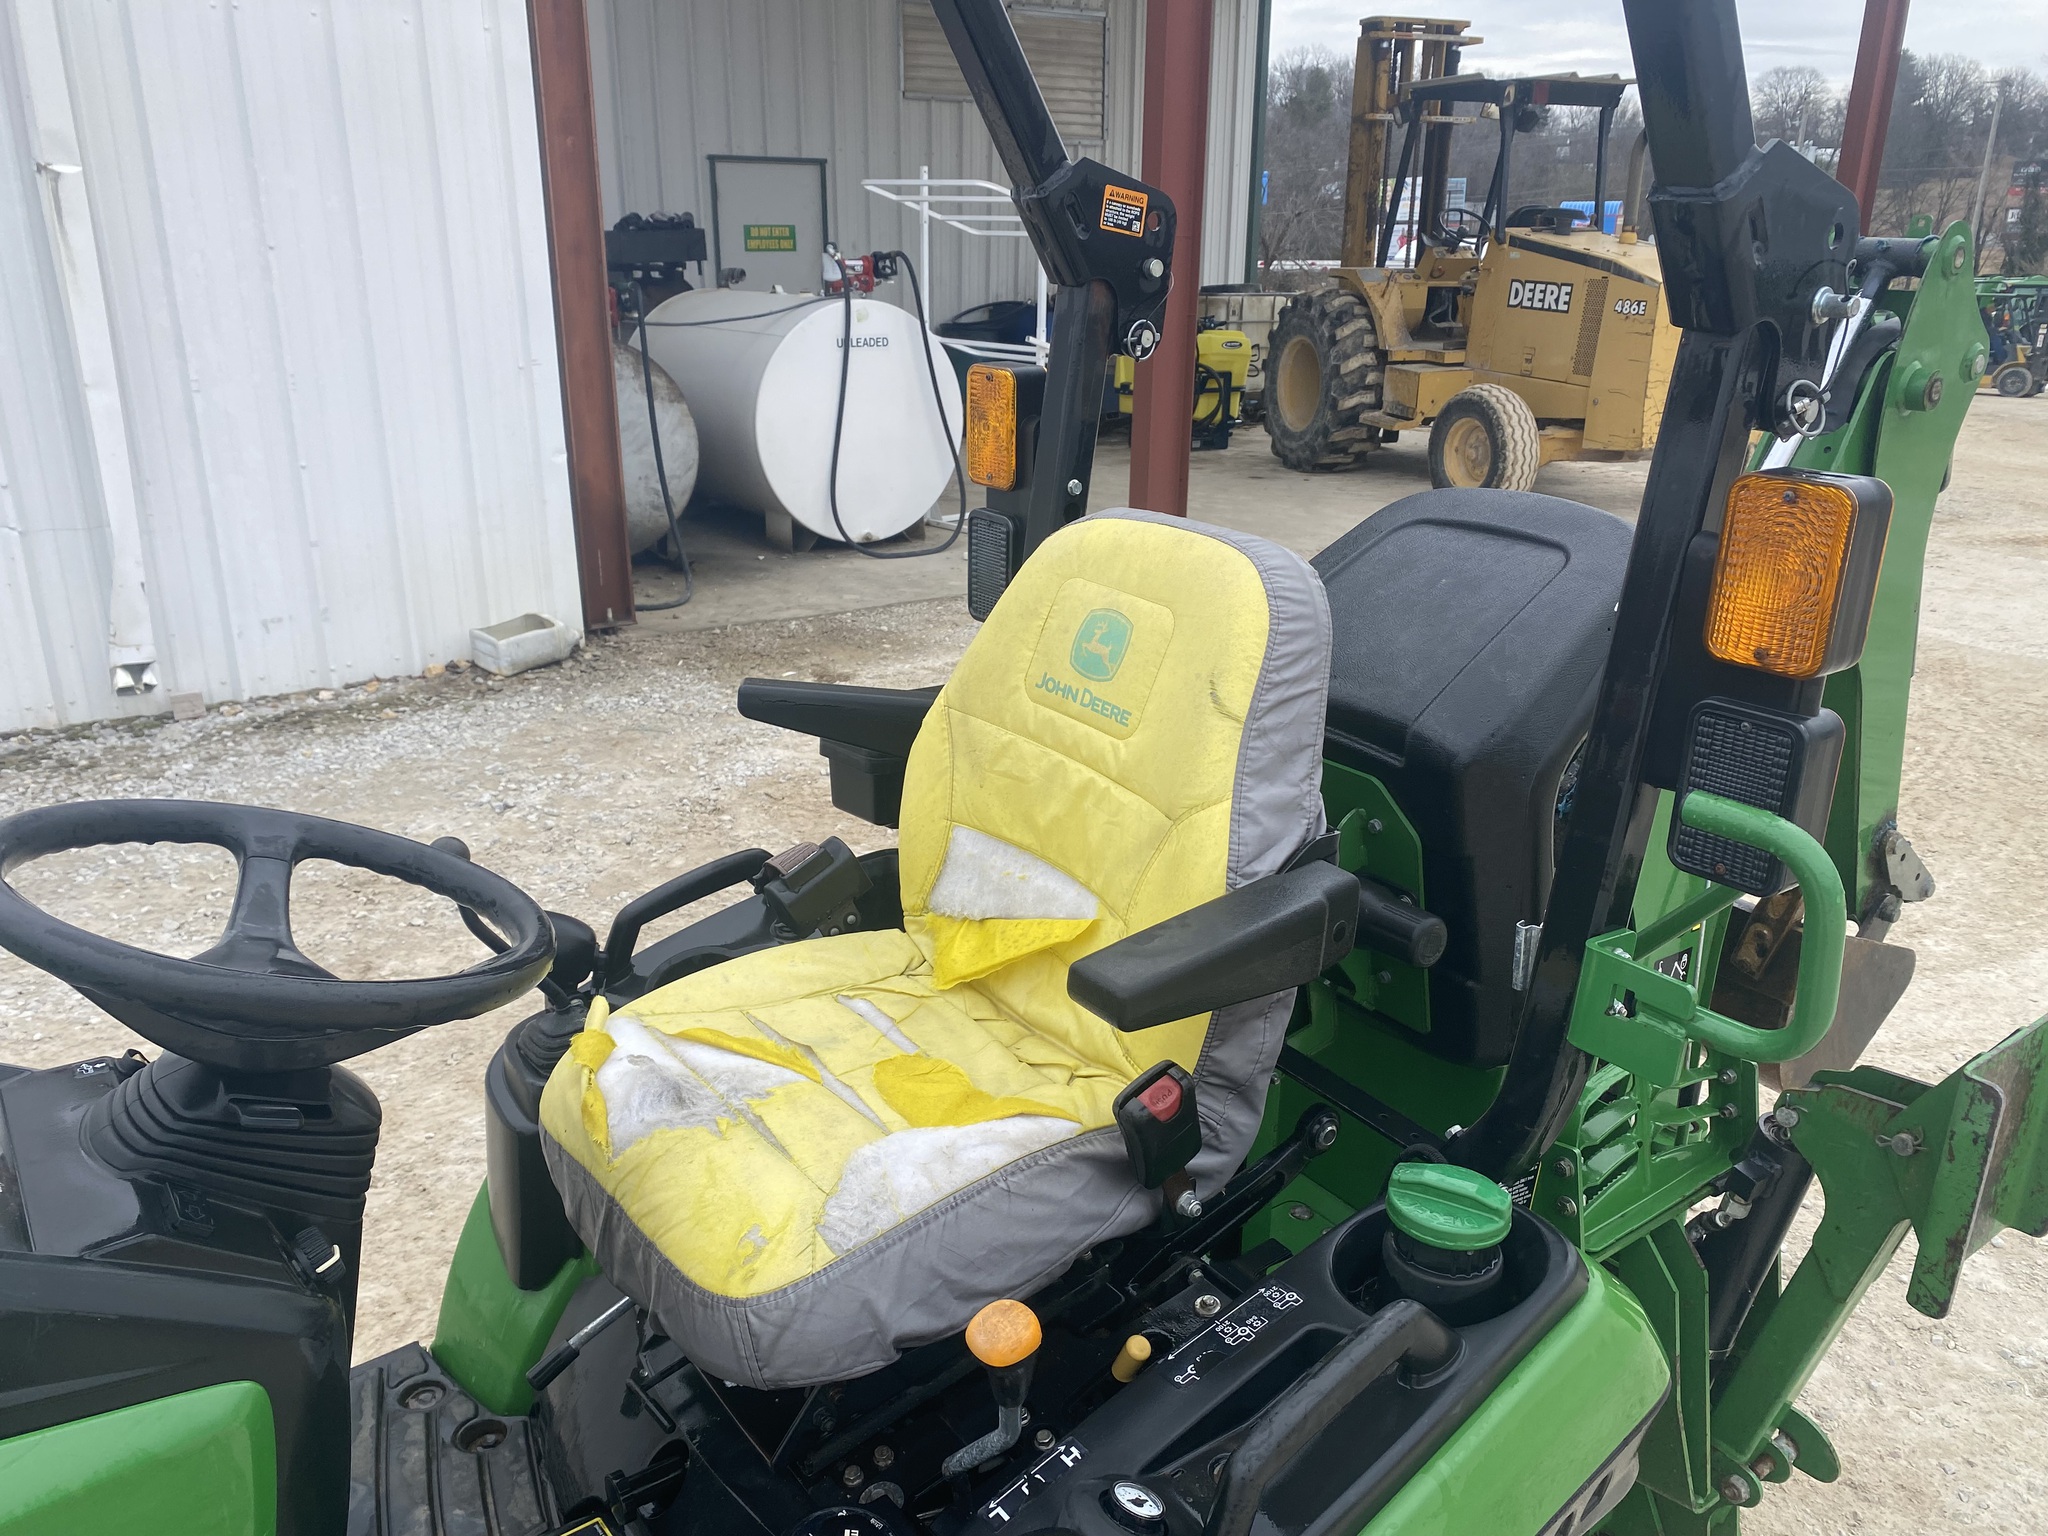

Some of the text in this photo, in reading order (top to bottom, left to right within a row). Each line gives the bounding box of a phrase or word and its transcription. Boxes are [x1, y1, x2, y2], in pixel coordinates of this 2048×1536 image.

[1115, 191, 1144, 205] WARNING
[1508, 280, 1572, 312] DEERE
[1614, 299, 1648, 316] 486E
[836, 337, 889, 349] ULEADED
[1035, 671, 1080, 704] JOHN
[1263, 1285, 1279, 1297] 2100
[1215, 1320, 1231, 1332] 2100
[1059, 1446, 1082, 1468] H
[988, 1505, 1011, 1522] L
